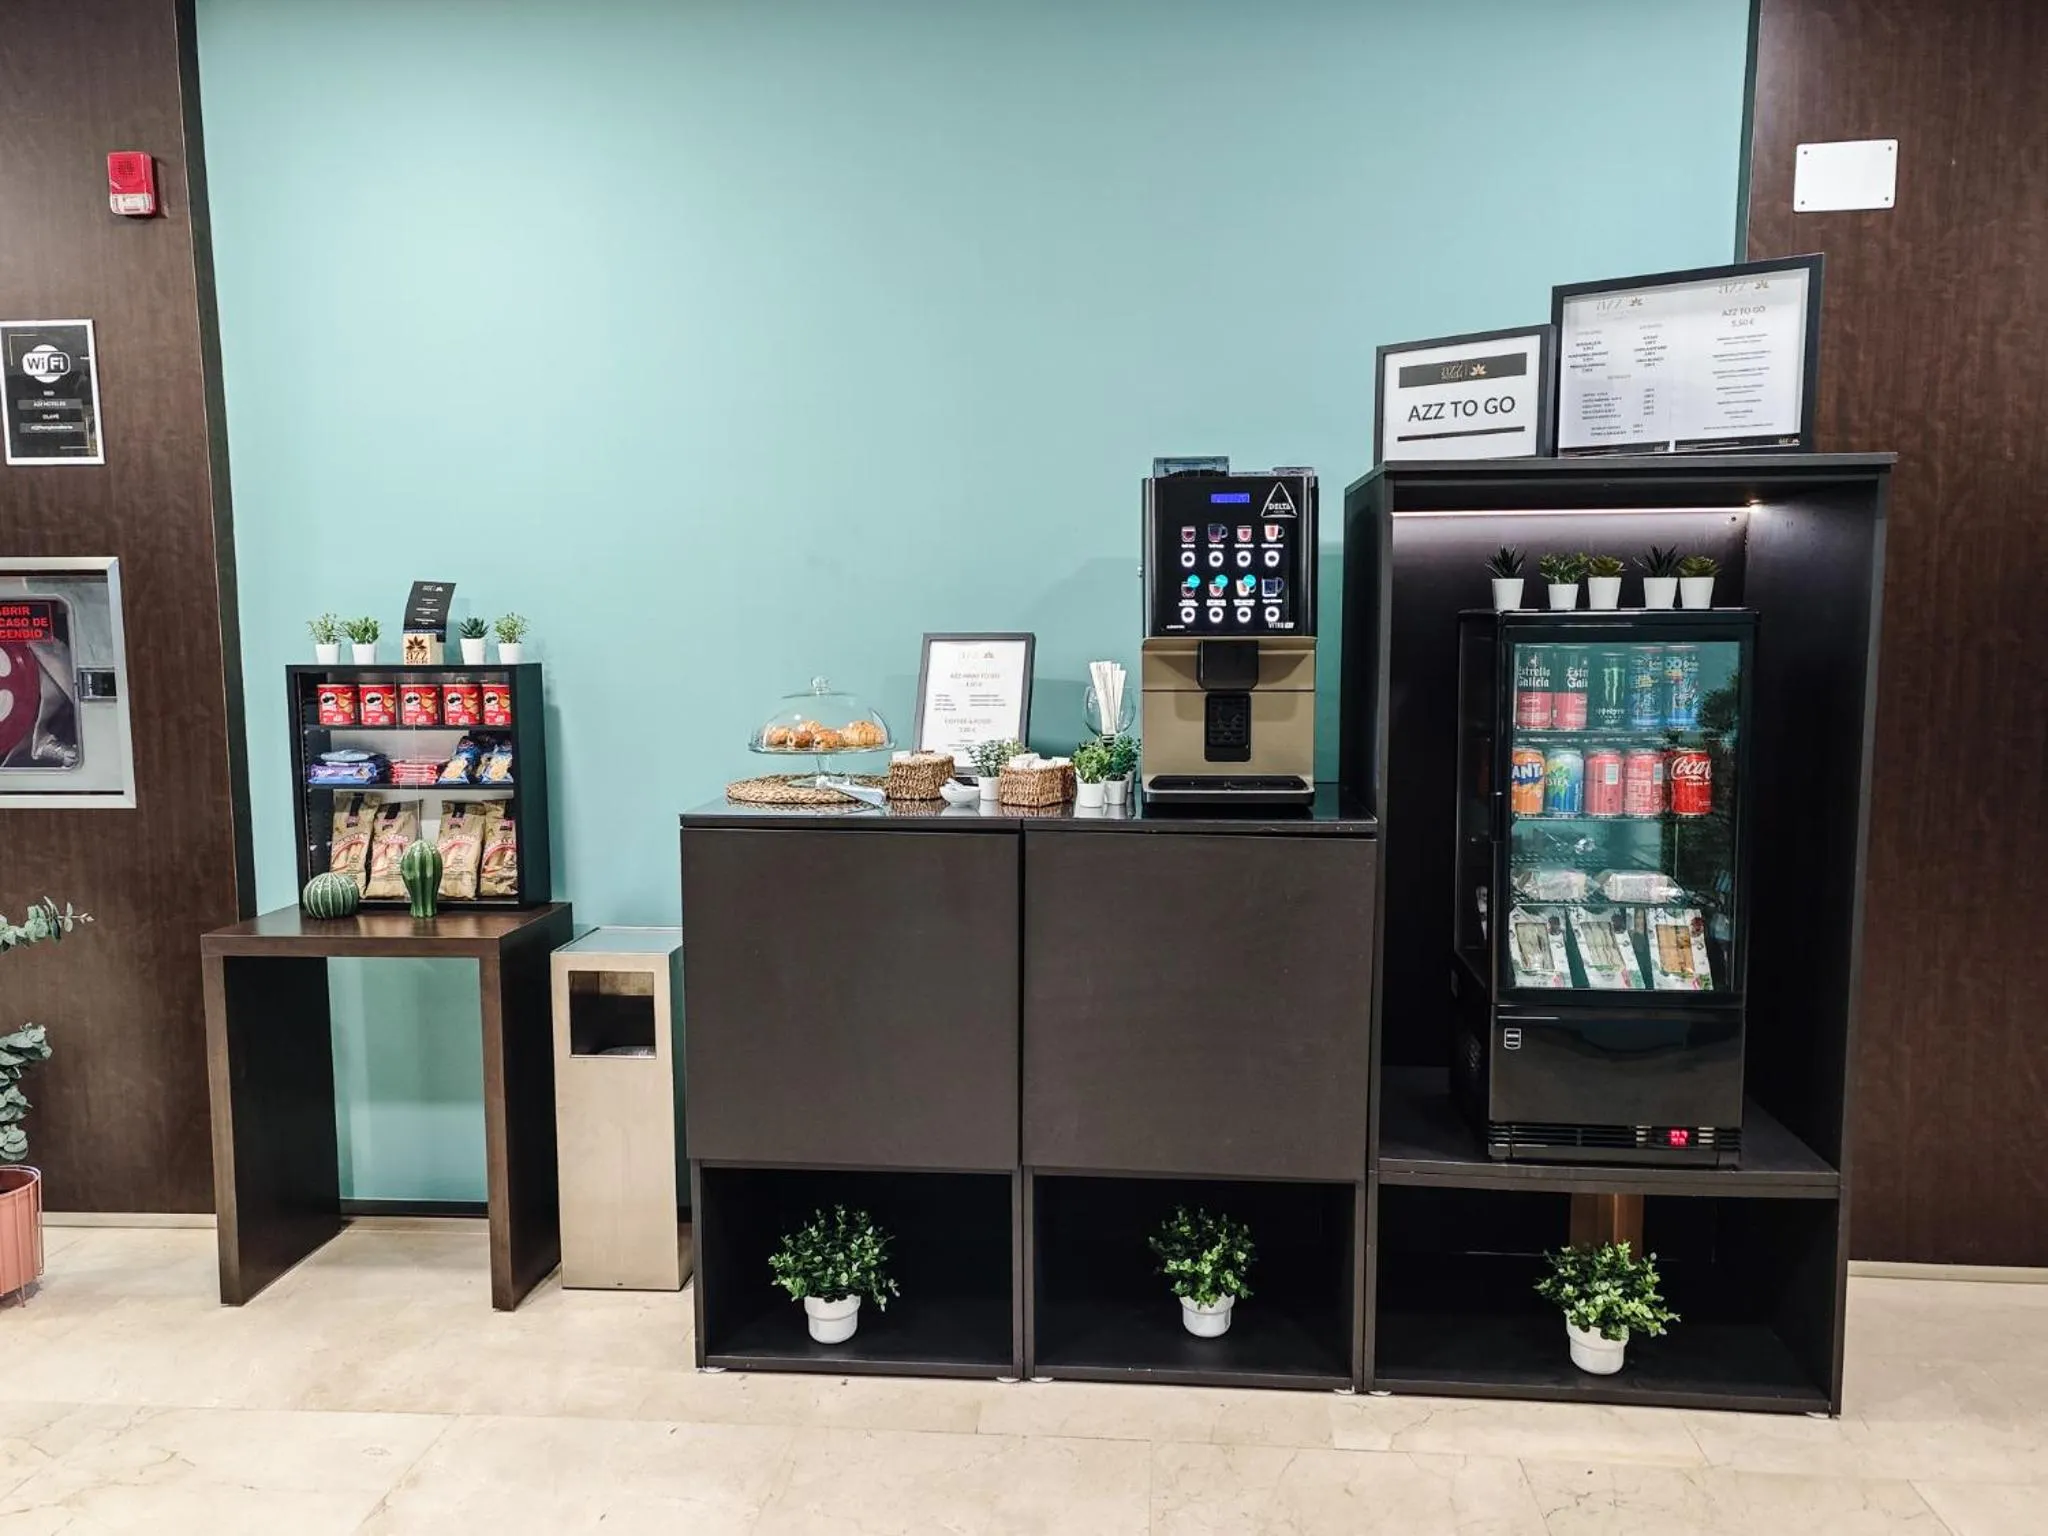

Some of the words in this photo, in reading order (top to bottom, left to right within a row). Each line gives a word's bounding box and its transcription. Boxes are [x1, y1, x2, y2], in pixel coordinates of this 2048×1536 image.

[1408, 403, 1445, 422] AZZ
[1450, 400, 1478, 418] TO
[1484, 396, 1515, 414] GO
[32, 617, 49, 627] DE
[1511, 762, 1544, 779] ANT
